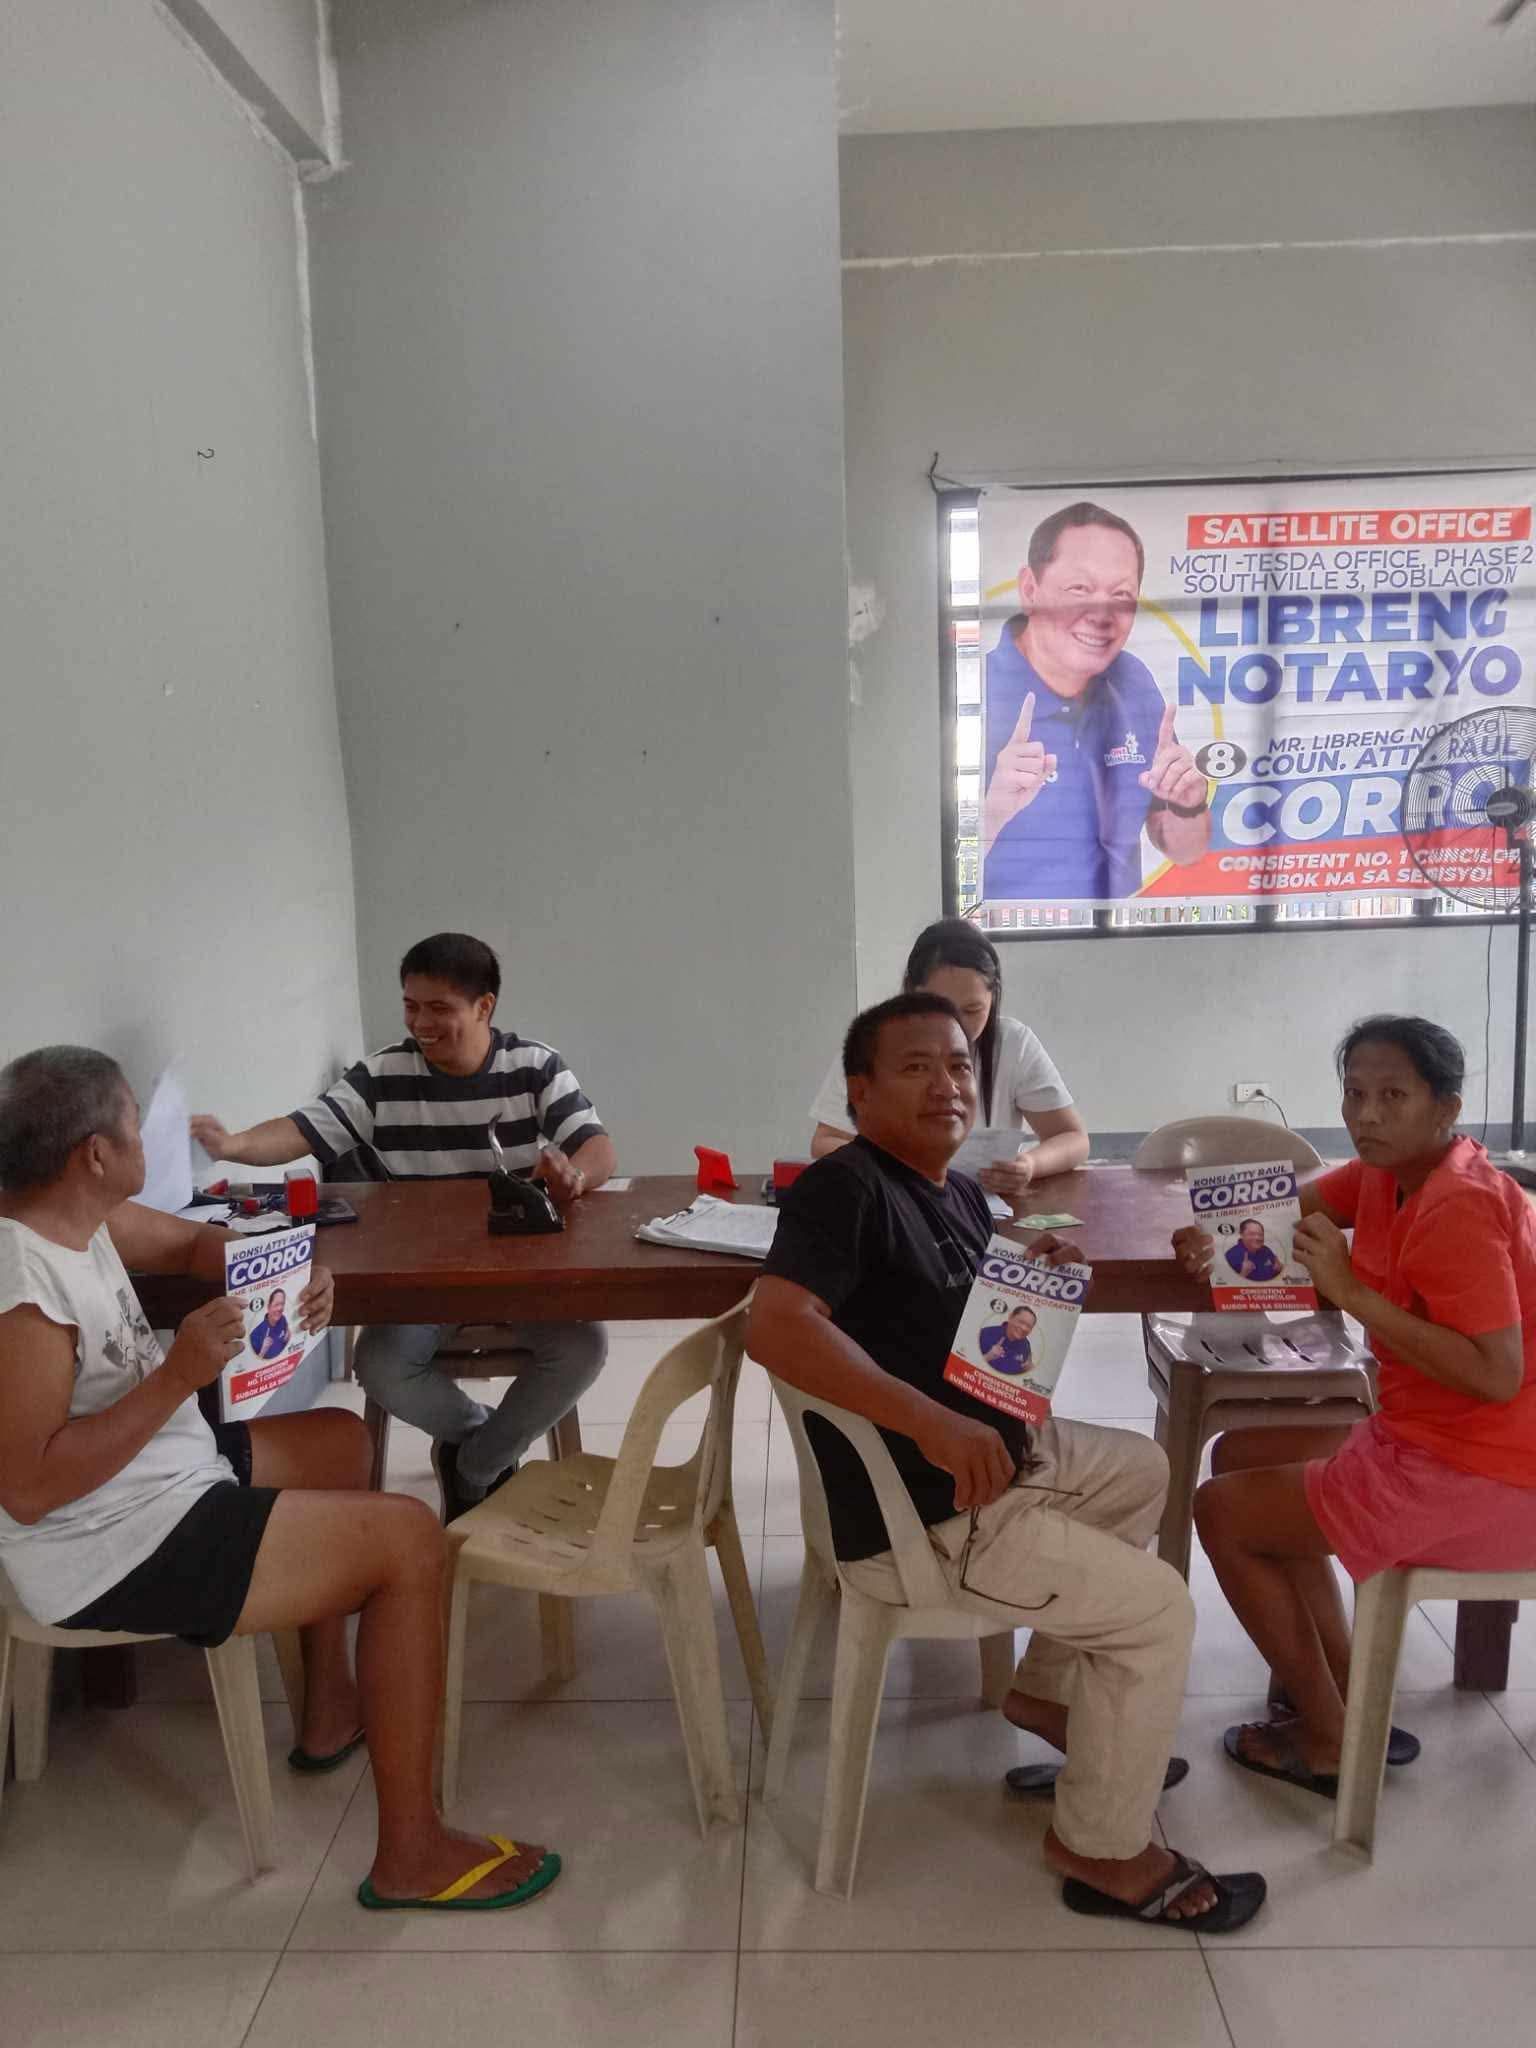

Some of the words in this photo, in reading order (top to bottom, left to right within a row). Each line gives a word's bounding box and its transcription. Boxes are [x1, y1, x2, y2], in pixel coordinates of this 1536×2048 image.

[1203, 514, 1379, 544] SATELLITE
[1390, 511, 1512, 541] OFFICE
[1170, 554, 1227, 575] MCTI
[1334, 549, 1426, 570] OFFICE,
[1183, 571, 1339, 594] SOUTHVILLE
[1345, 570, 1366, 592] 3,
[1373, 566, 1518, 589] POBLACION
[1199, 587, 1511, 647] LIBRENG
[1178, 645, 1523, 706] NOTARYO
[1268, 736, 1306, 754] MR.
[1311, 728, 1405, 751] LIBRENG
[1204, 741, 1238, 778] 8
[1250, 750, 1348, 778] COUN.
[1447, 735, 1519, 759] RAUL
[1218, 852, 1351, 872] CONSISTENT
[1354, 850, 1392, 867] NO.
[1399, 848, 1409, 865] 1
[1247, 872, 1321, 890] SUBOK
[1324, 871, 1356, 887] NA
[1361, 868, 1392, 884] SA
[1193, 1174, 1226, 1187] KONSI
[1228, 1169, 1257, 1184] ATTY
[1258, 1165, 1287, 1179] RAUL
[1193, 1175, 1293, 1210] CORRO
[230, 1240, 311, 1286] CORRO
[232, 1246, 264, 1262] KONSI
[983, 1258, 1084, 1301] CORRO
[250, 1297, 264, 1313] 8
